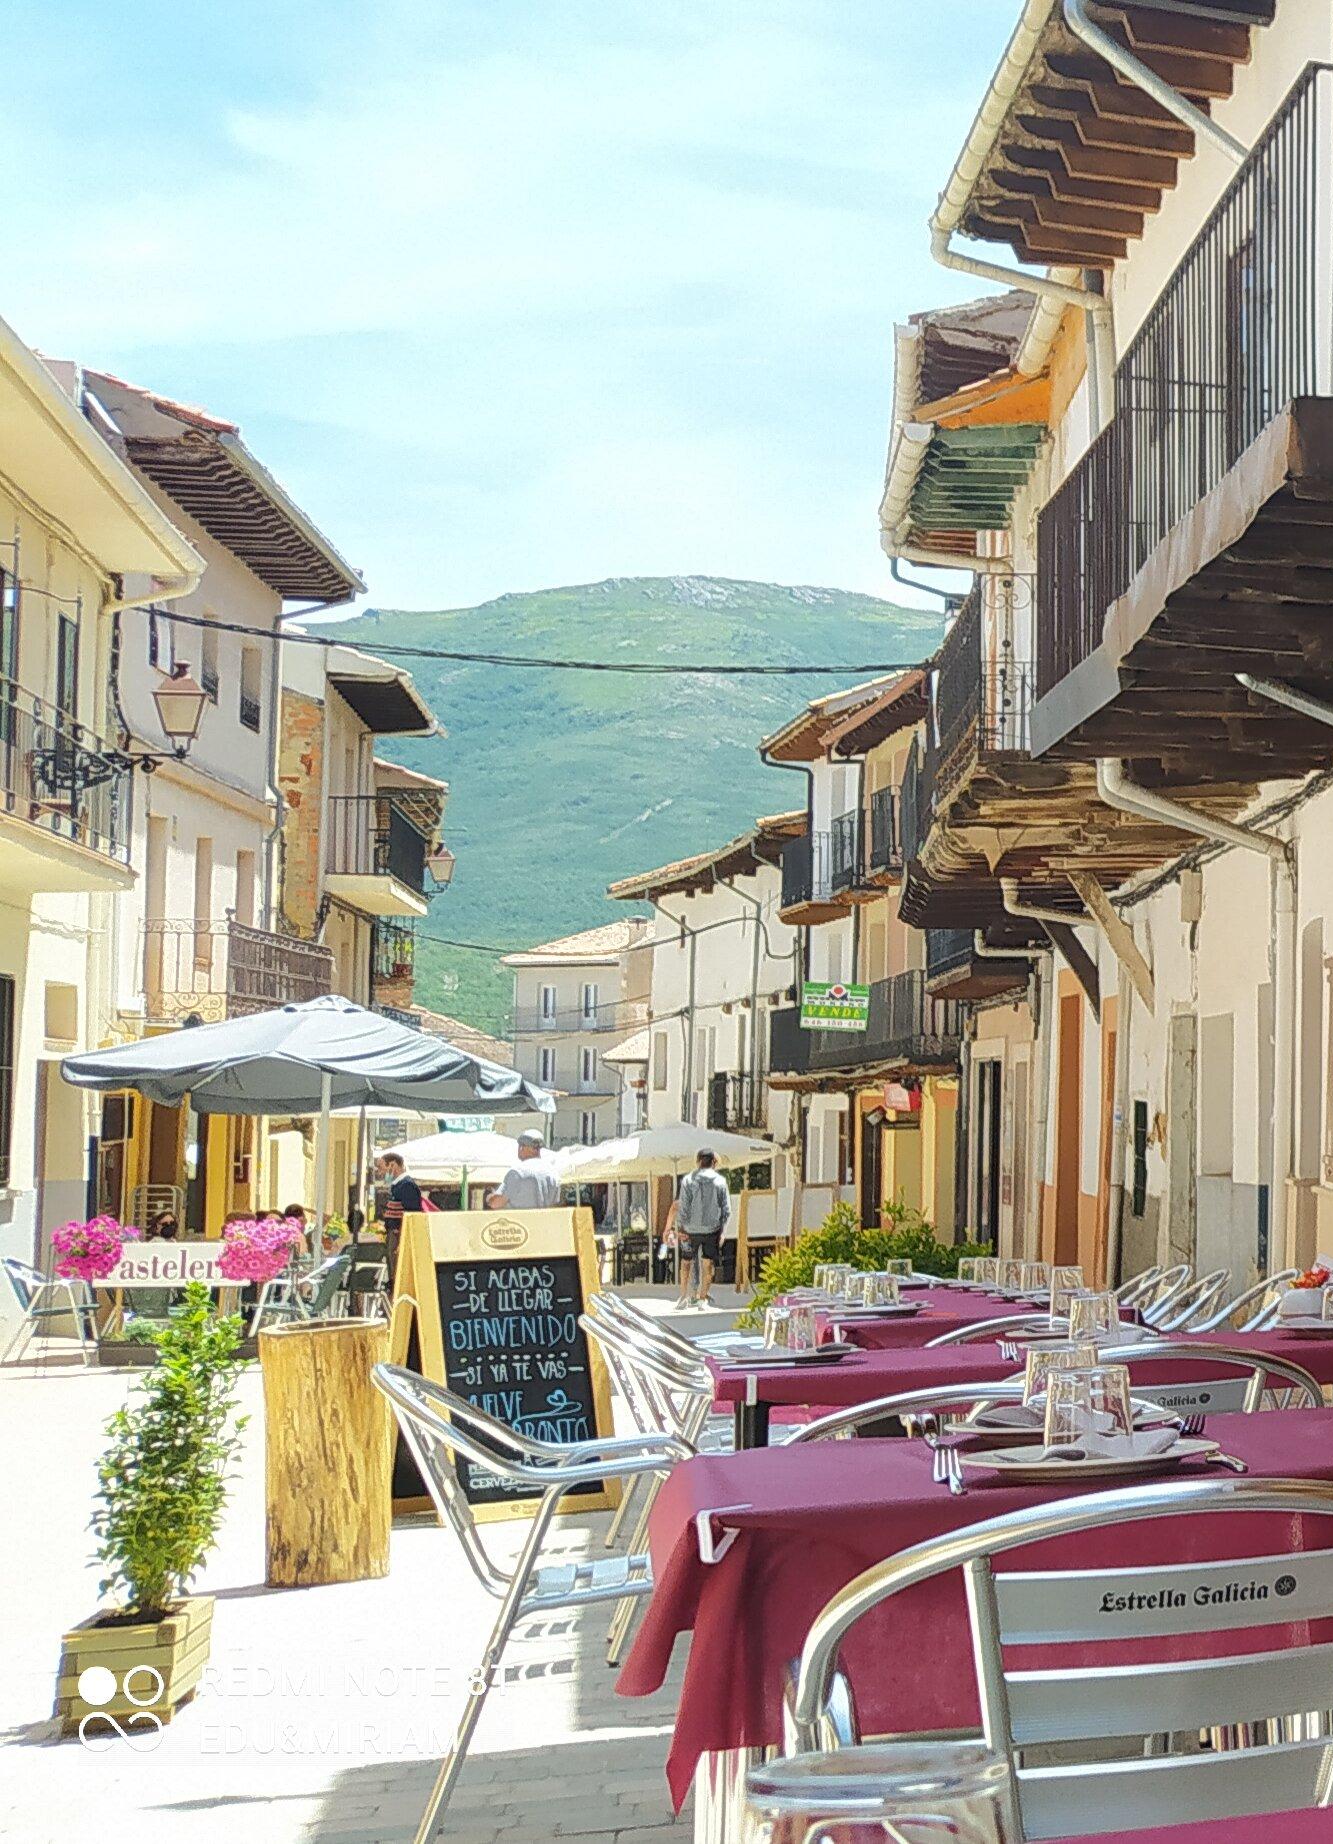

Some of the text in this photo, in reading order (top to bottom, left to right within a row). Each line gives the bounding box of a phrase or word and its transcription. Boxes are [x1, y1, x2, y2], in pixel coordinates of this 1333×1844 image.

[807, 1005, 862, 1019] VENDE
[454, 1265, 555, 1291] SI ACABAS
[469, 1289, 553, 1313] DE LLEGAR
[449, 1313, 576, 1350] BIENVENIDO
[465, 1360, 567, 1385] SI YA TE VAS
[1157, 1394, 1197, 1408] Galicia
[1098, 1581, 1269, 1613] Estrella Galicia
